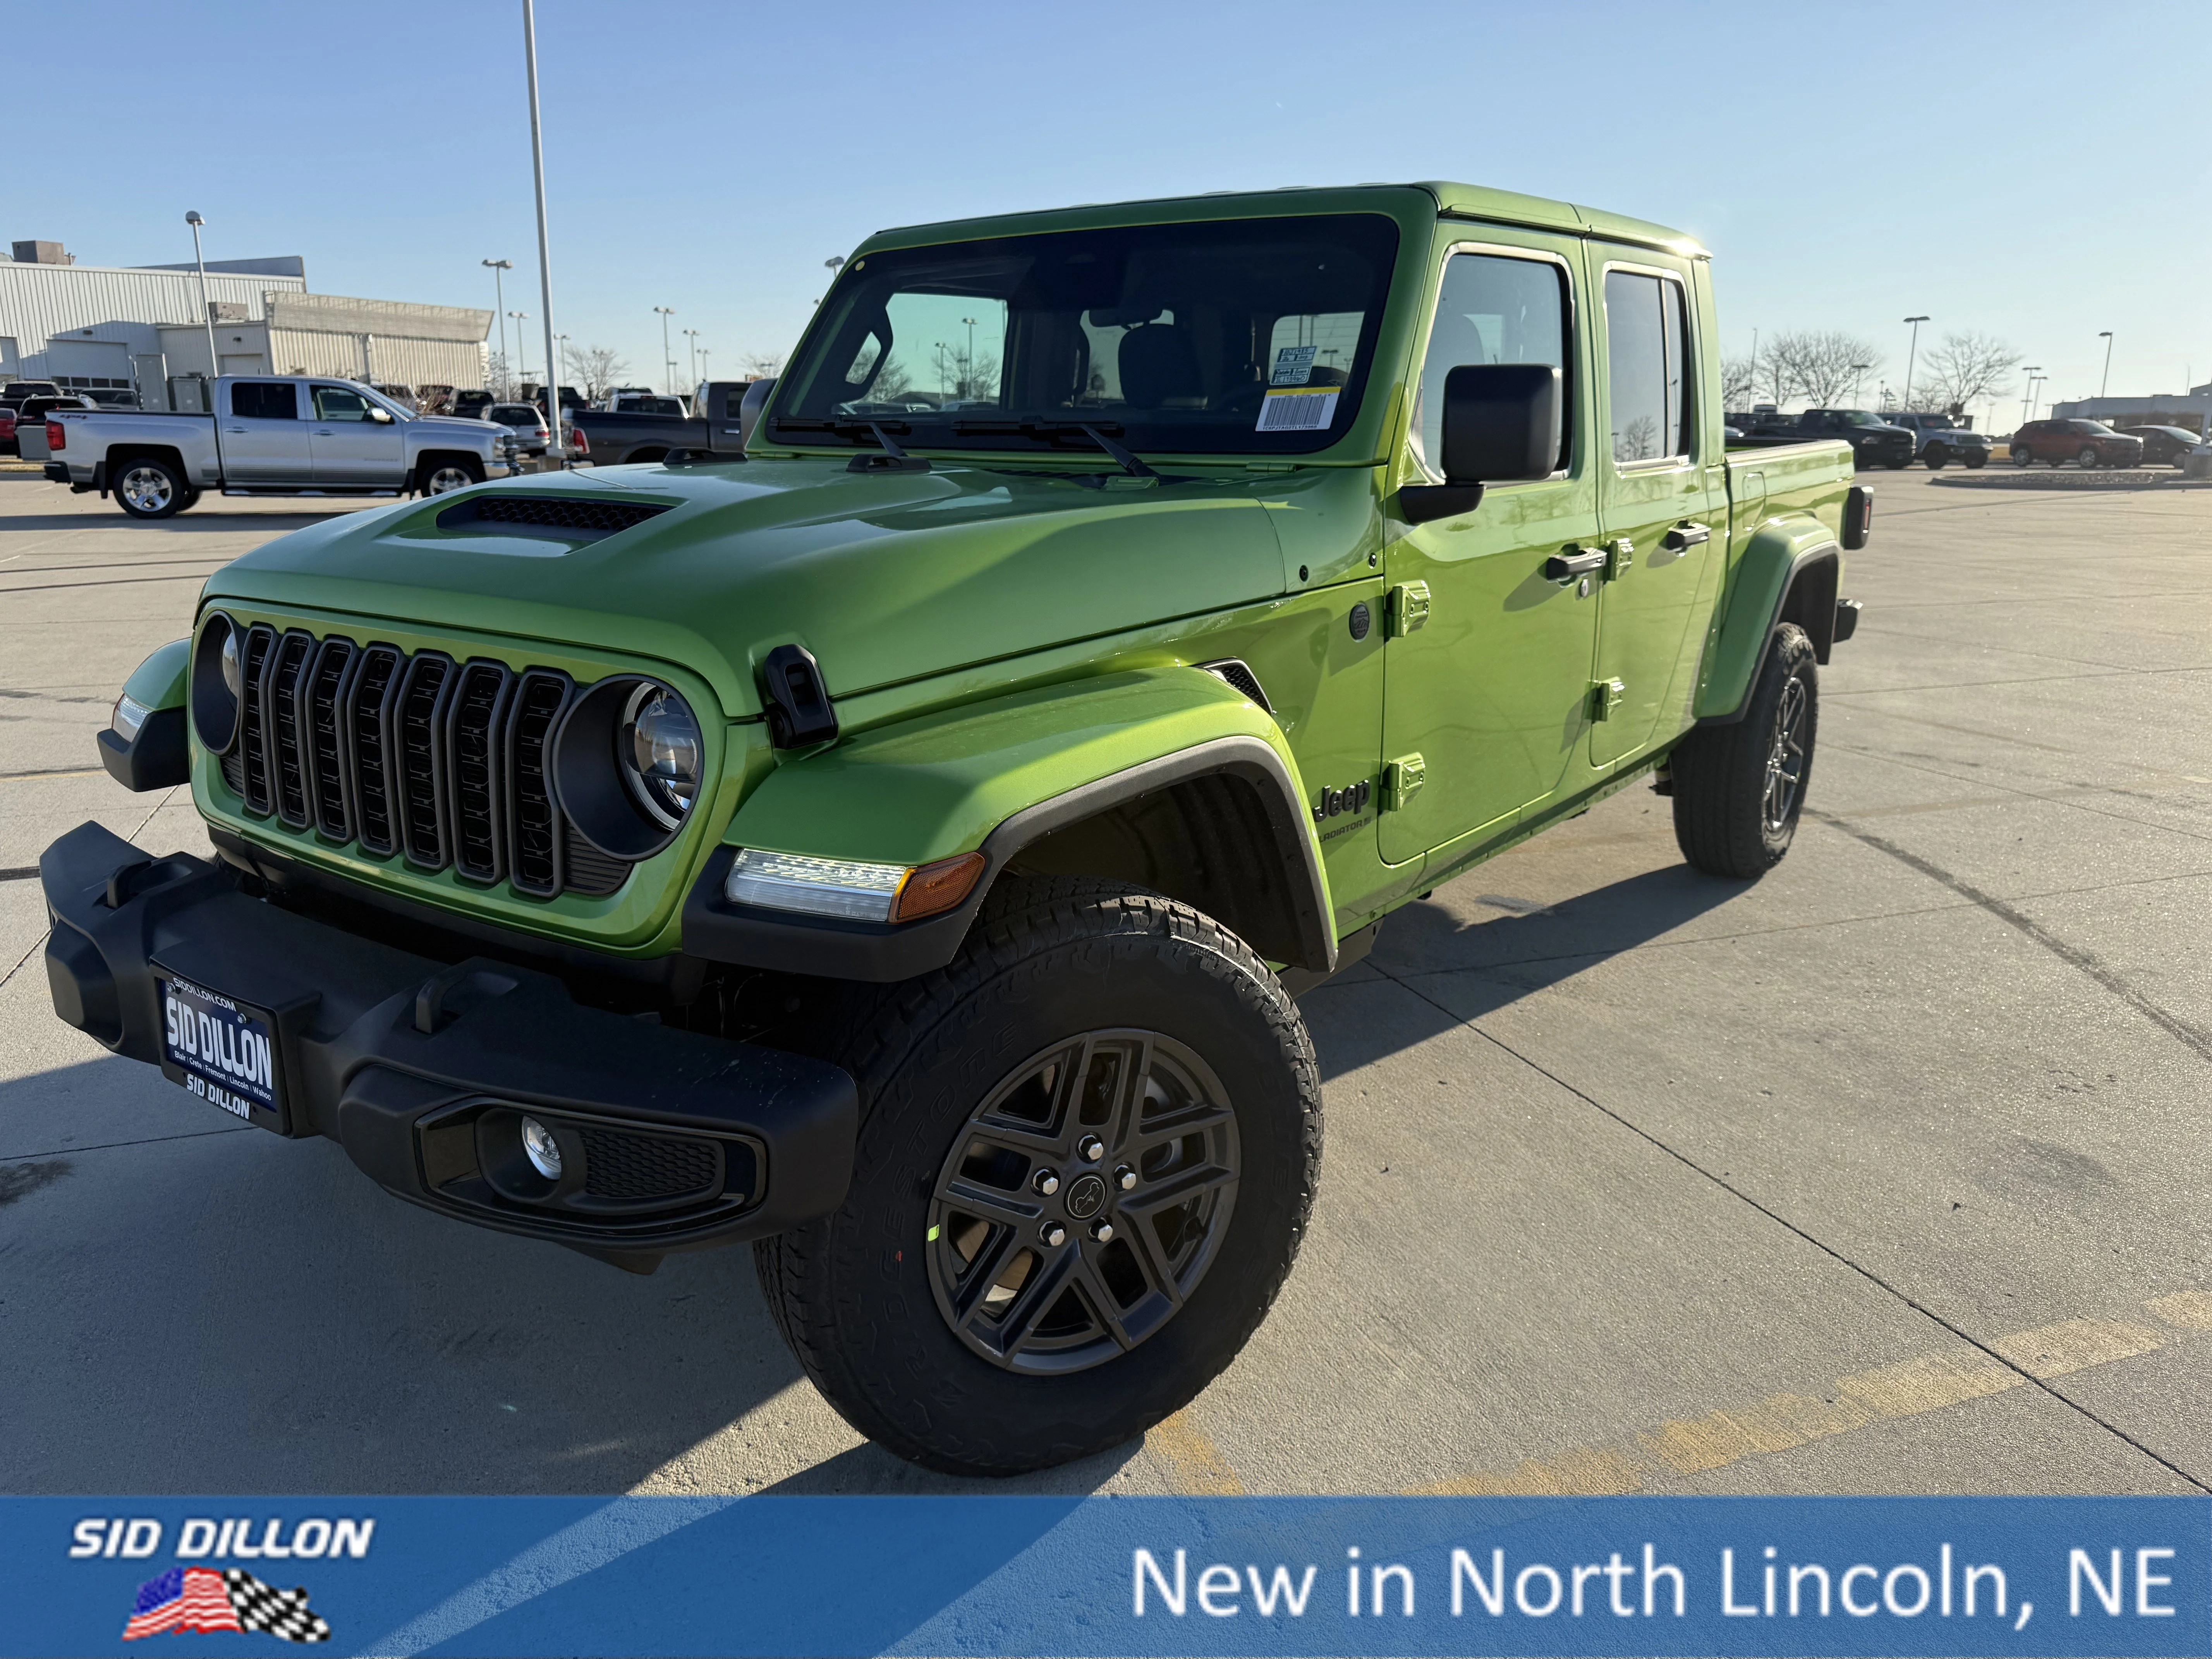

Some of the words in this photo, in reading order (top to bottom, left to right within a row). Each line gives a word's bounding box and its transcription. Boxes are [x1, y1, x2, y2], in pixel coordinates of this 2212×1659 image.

[1312, 779, 1370, 823] Jeep
[1318, 819, 1363, 843] LADIATOR
[173, 977, 237, 1012] SIDDILLON.COM
[166, 996, 198, 1056] SID
[198, 1011, 273, 1090] DILLON
[174, 1050, 186, 1062] Blair
[189, 1058, 203, 1070] Crete
[205, 1065, 226, 1081] Fremont
[229, 1076, 249, 1091] Lincoln
[252, 1085, 271, 1101] Wahoo
[187, 1073, 205, 1097] SID
[208, 1083, 250, 1120] DILLON
